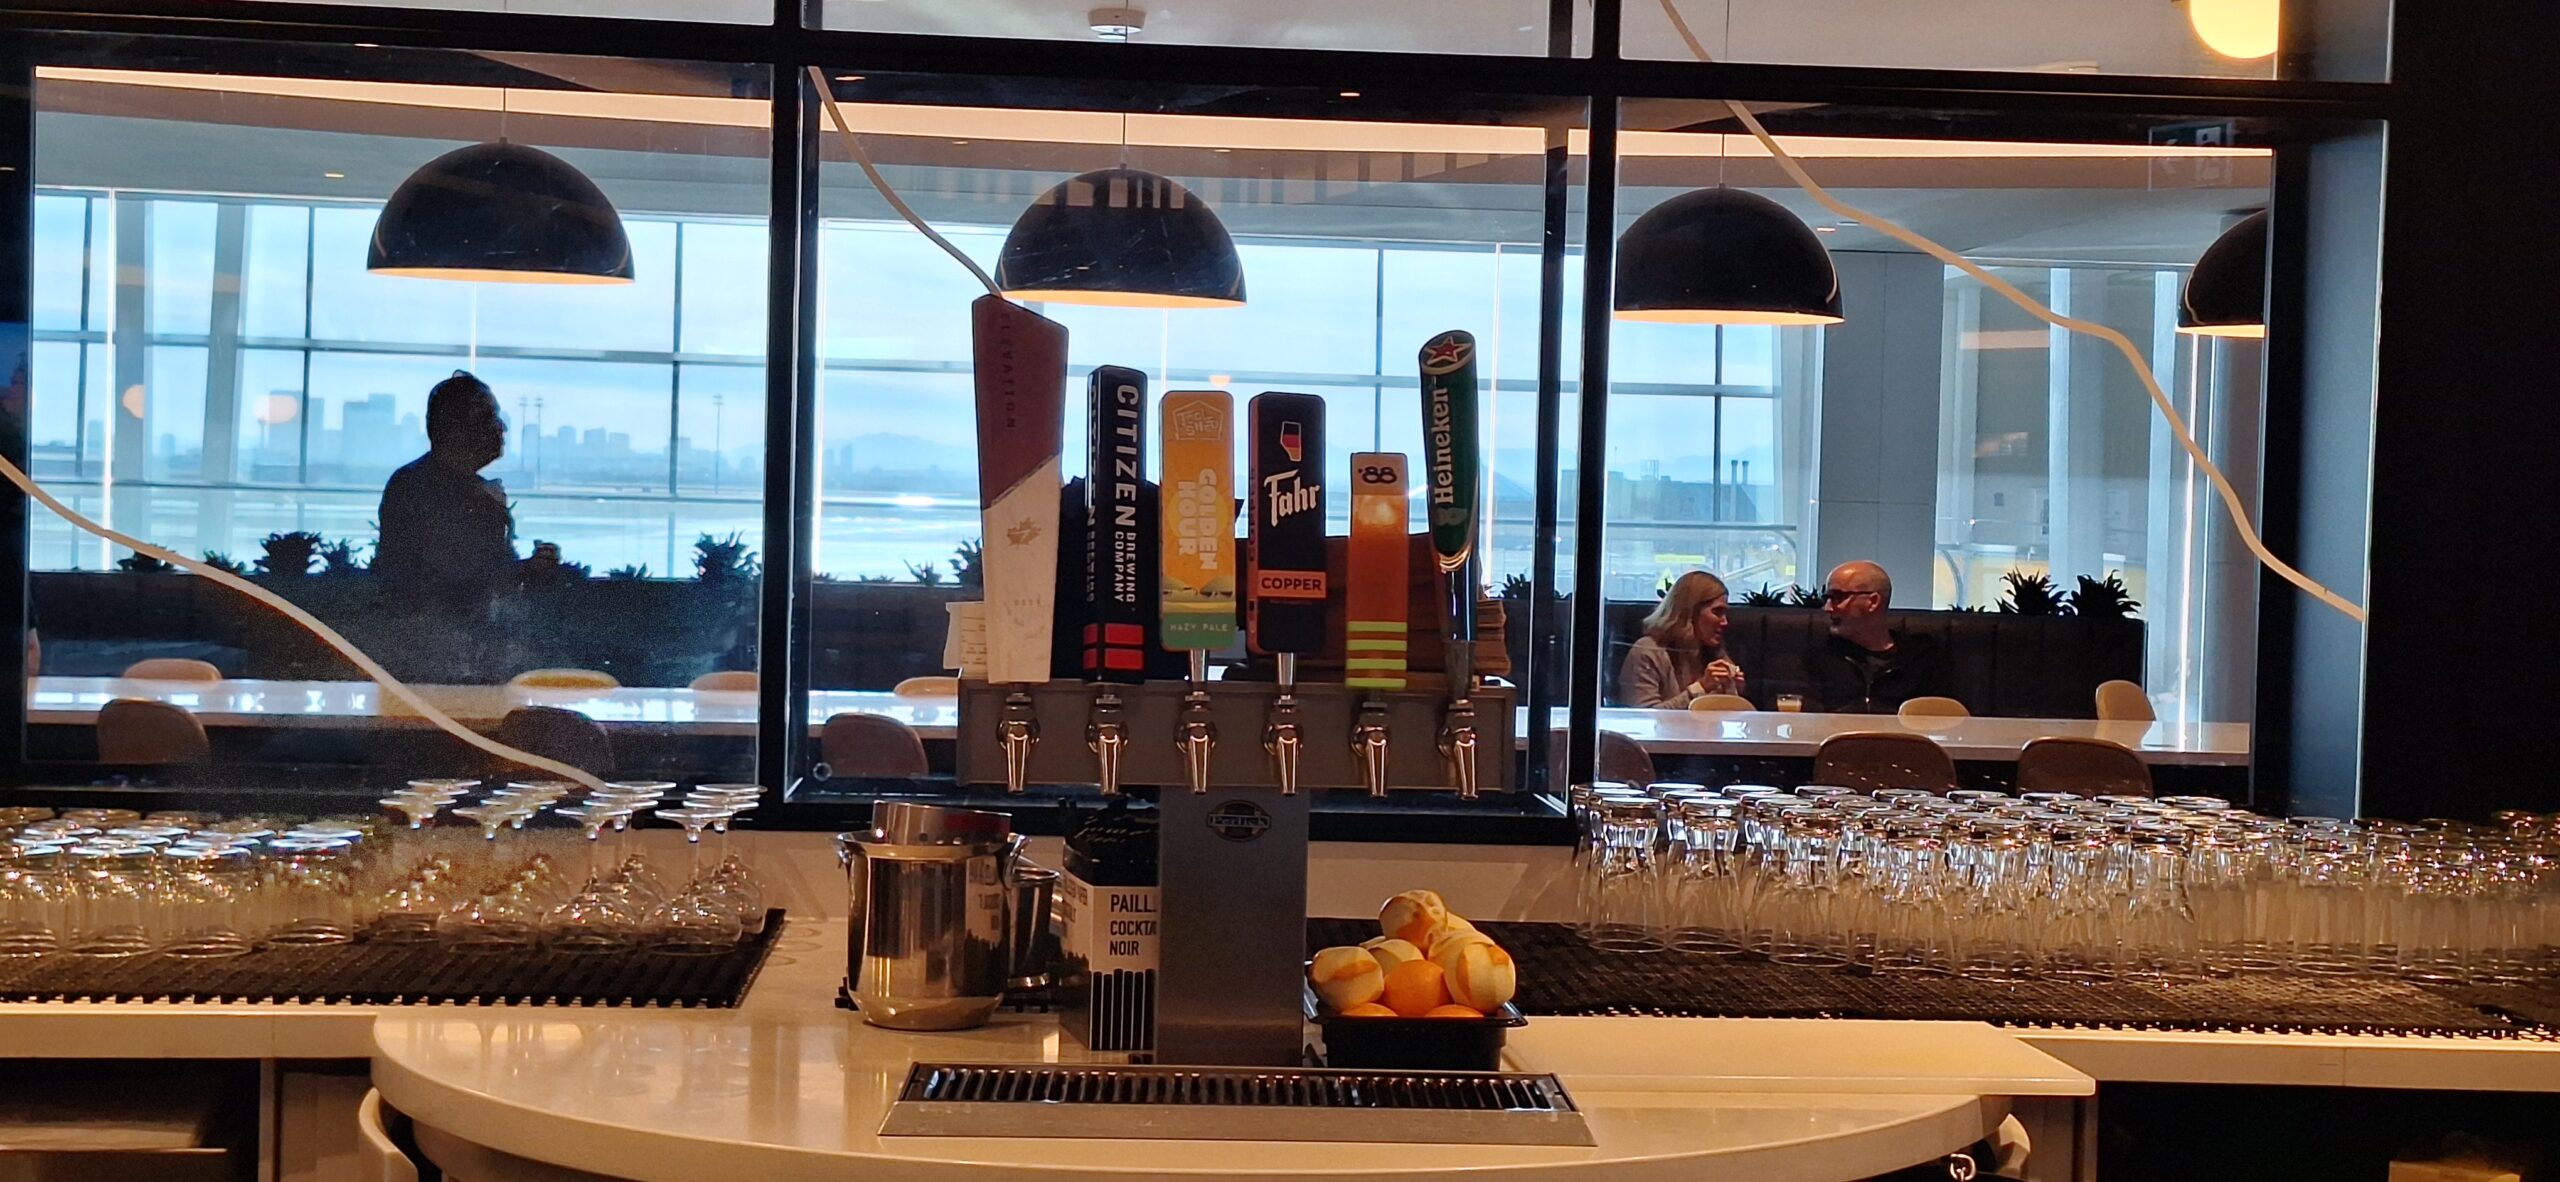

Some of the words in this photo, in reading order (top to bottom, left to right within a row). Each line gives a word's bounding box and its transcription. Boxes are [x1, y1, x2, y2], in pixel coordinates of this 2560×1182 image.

[1001, 312, 1016, 428] ELEVATION
[1115, 384, 1139, 527] CITIZEN
[1431, 388, 1454, 504] Heineken
[1177, 481, 1197, 556] HOUR
[1199, 468, 1217, 570] GOLDEN
[1264, 469, 1320, 527] Fahr
[1114, 531, 1124, 602] COMPANY
[1126, 532, 1136, 603] BREWING
[1261, 577, 1322, 591] COPPER
[1170, 623, 1196, 632] HAZY
[1203, 624, 1228, 632] PALE
[1110, 894, 1157, 913] PAILL
[1109, 941, 1139, 956] NOIR
